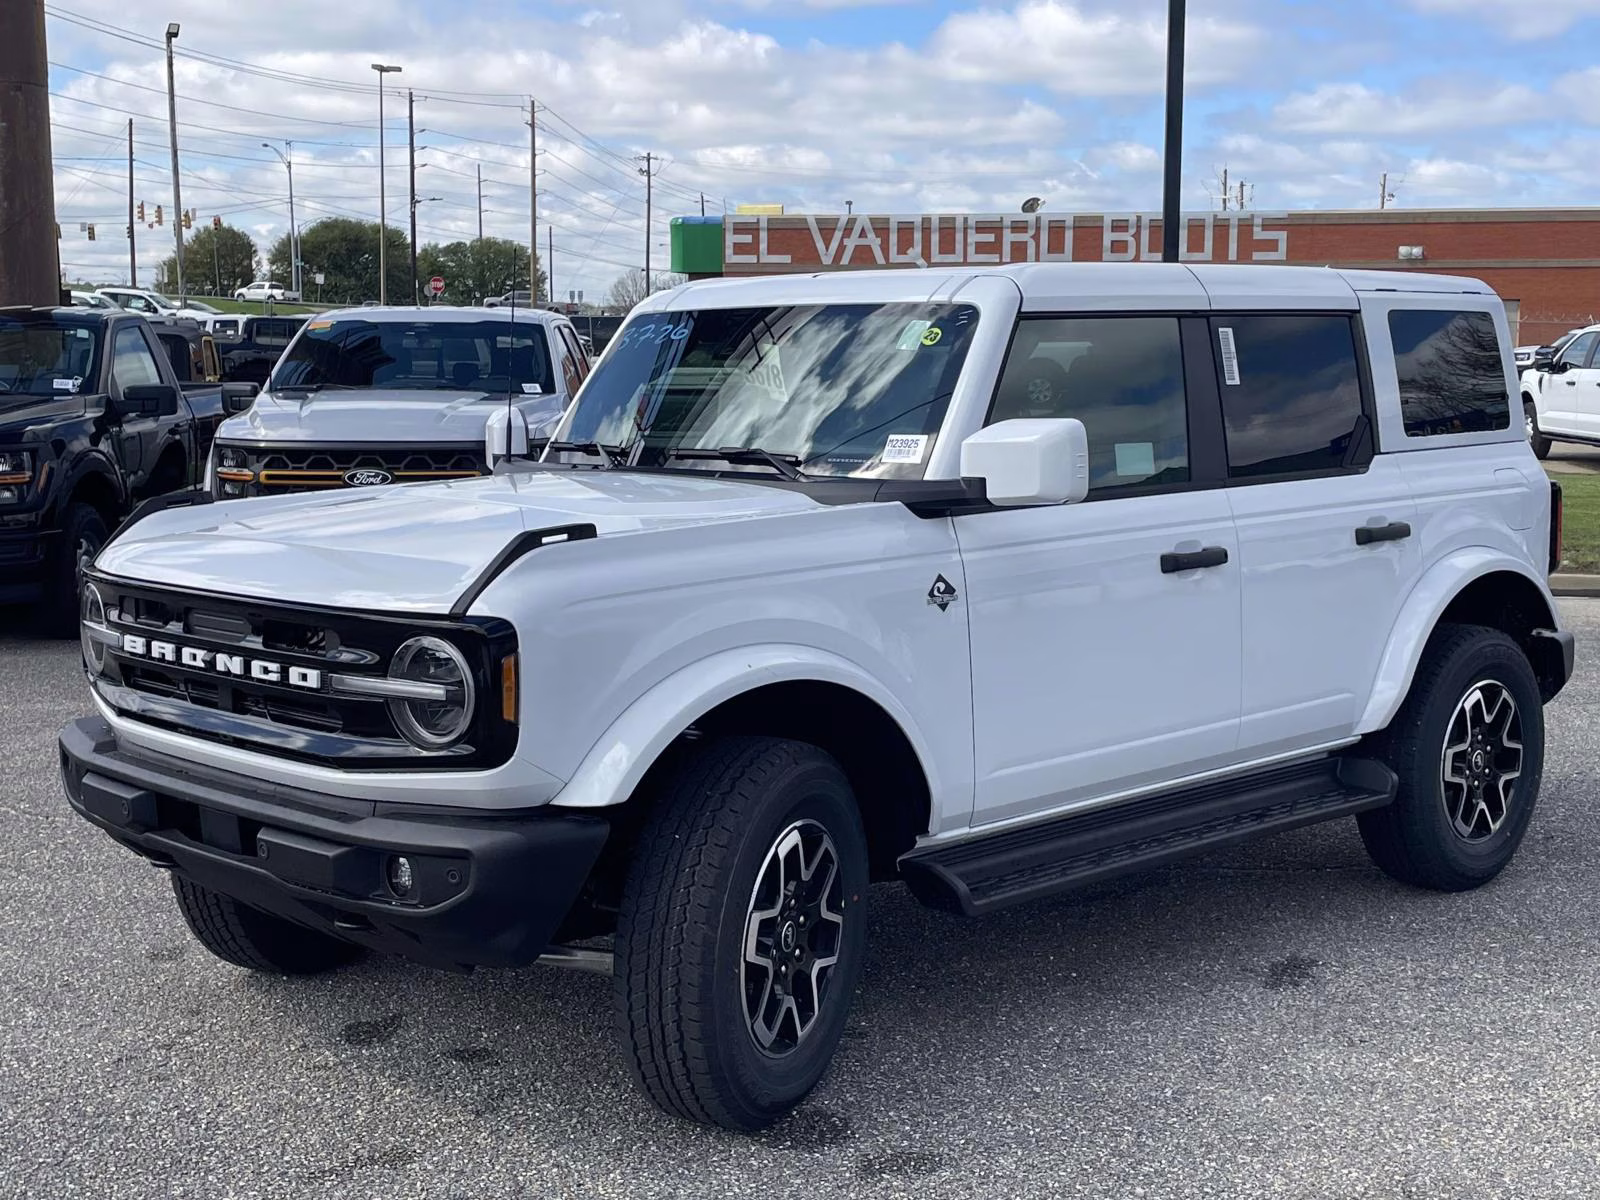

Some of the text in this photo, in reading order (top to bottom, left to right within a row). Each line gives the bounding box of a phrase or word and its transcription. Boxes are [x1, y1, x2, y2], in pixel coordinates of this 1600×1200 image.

[725, 211, 1289, 268] EL VAQUERO BOOTS
[923, 330, 939, 342] 23
[353, 472, 382, 484] Ford
[123, 634, 321, 689] BRONCO
